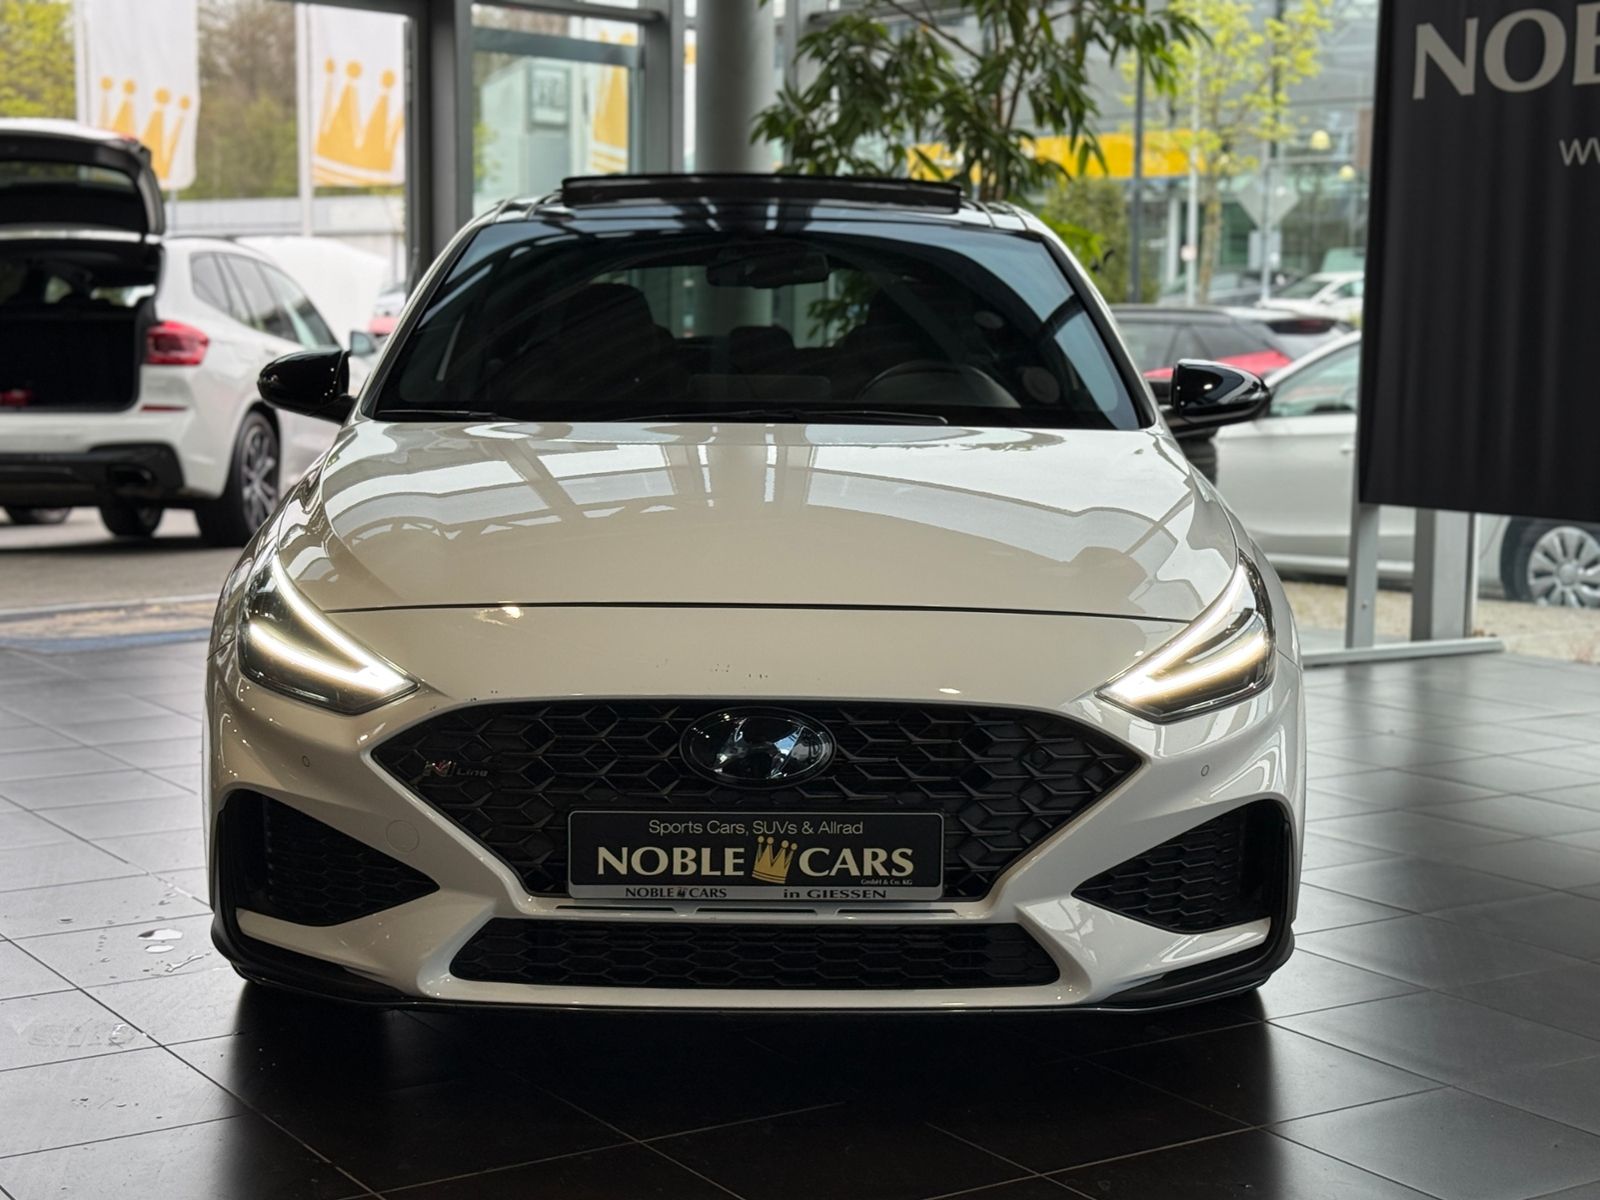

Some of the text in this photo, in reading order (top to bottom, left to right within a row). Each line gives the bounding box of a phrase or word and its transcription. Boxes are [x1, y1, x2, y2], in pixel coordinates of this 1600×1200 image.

[649, 819, 864, 836] Sports Cars, SUVs & Allrad
[597, 846, 914, 877] NOBLE CARS
[902, 878, 913, 886] KG
[625, 887, 728, 899] NOBLE CARS
[783, 888, 887, 899] in GIESSEN
